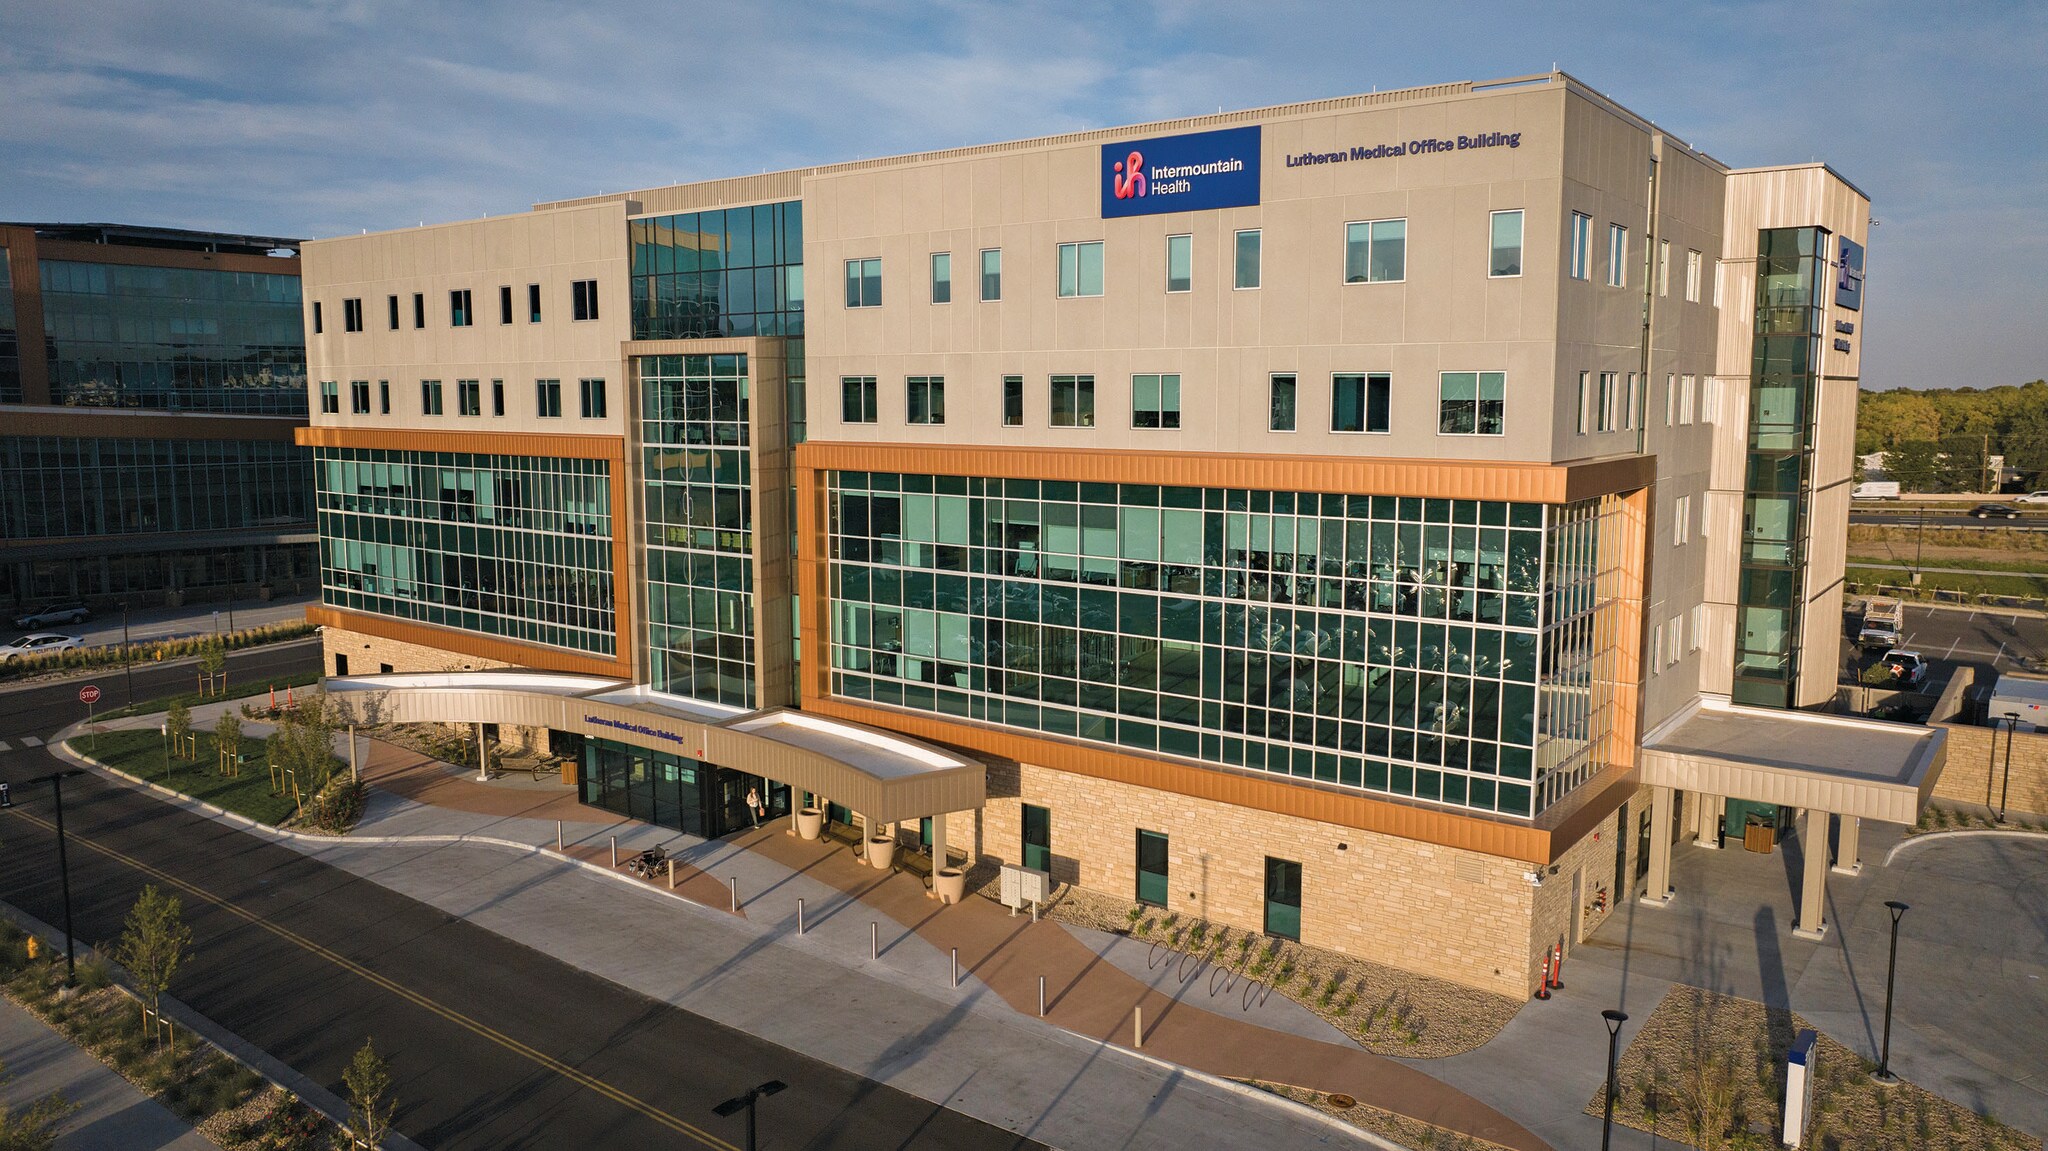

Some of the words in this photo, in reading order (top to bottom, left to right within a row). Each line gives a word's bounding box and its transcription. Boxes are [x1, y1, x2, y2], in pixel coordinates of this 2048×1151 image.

[1286, 154, 1347, 168] Lutheran
[1350, 142, 1406, 161] Medical
[1409, 138, 1454, 155] Office
[1457, 132, 1521, 150] Building
[1151, 158, 1243, 180] Intermountain
[1151, 180, 1191, 196] Health
[82, 690, 99, 699] STOP
[584, 714, 613, 727] Lutheran
[613, 720, 637, 733] Medical
[638, 725, 656, 737] Office
[657, 730, 684, 745] Building
